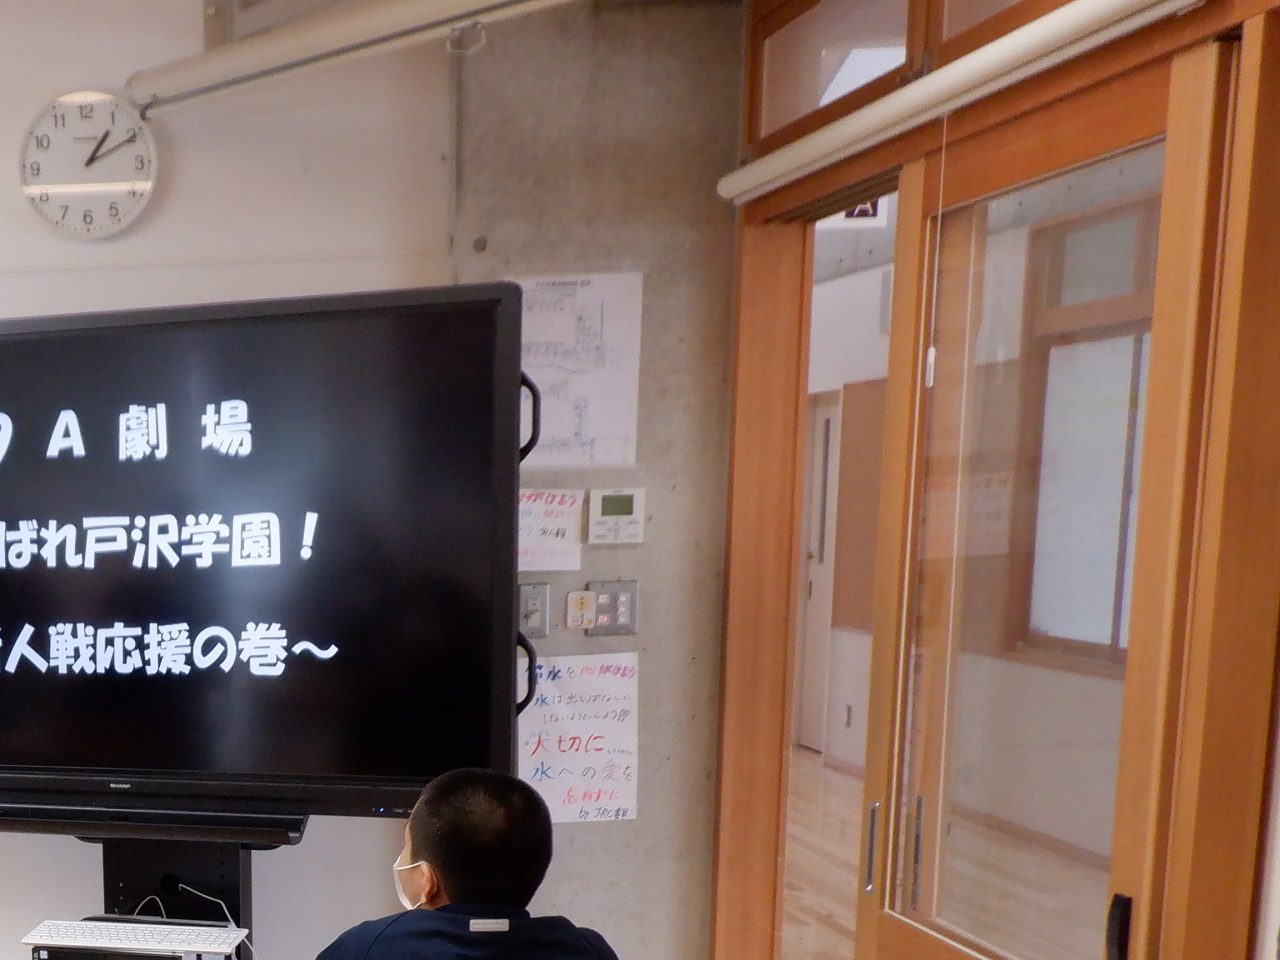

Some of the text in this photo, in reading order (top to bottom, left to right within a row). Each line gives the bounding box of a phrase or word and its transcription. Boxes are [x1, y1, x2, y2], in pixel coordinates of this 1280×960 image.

[78, 104, 94, 119] 12
[110, 111, 116, 126] 1
[53, 112, 66, 128] 11
[35, 134, 51, 149] 10
[30, 161, 41, 176] 9
[135, 154, 145, 170] 3
[60, 205, 69, 220] 7
[109, 202, 119, 217] 5
[83, 210, 93, 225] 6
[46, 409, 87, 459] A
[118, 403, 168, 463] 劇
[201, 399, 252, 458] 場
